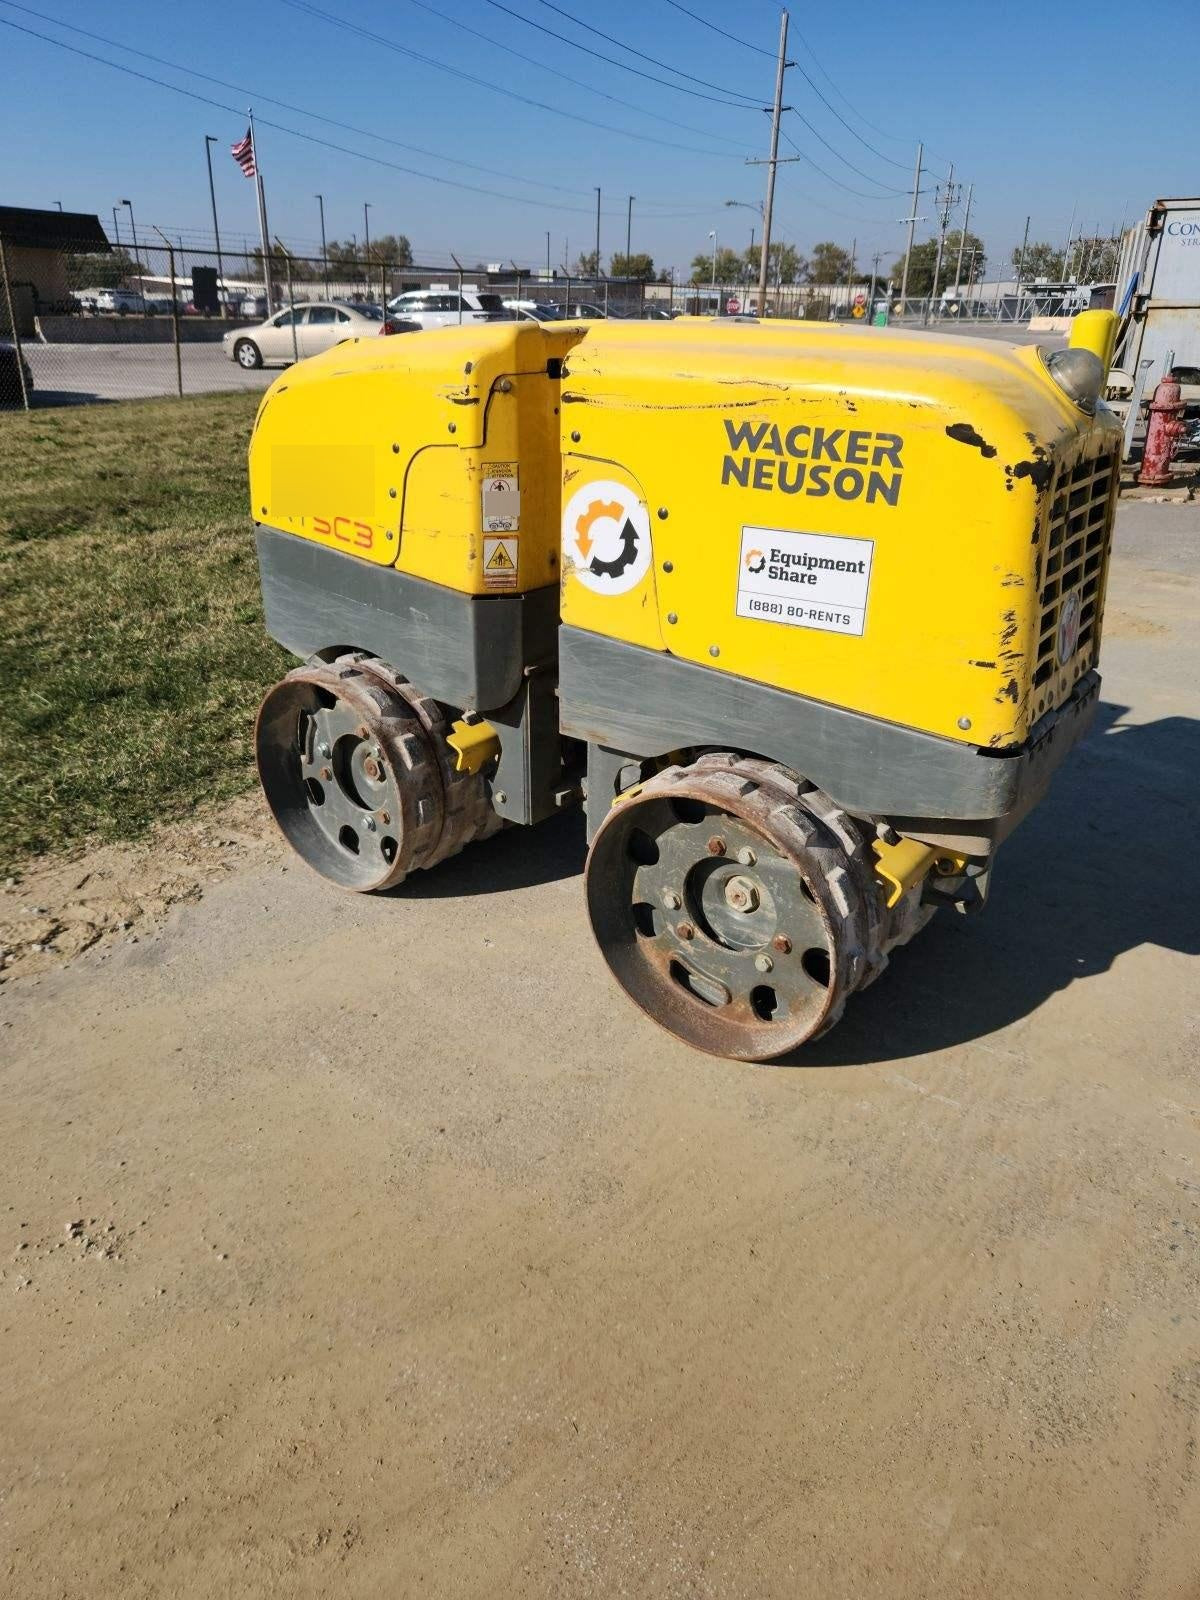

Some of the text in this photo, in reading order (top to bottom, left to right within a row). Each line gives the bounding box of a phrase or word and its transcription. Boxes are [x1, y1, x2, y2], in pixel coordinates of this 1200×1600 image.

[1180, 238, 1200, 246] STR
[723, 419, 904, 468] WACKER
[721, 455, 902, 506] NEUSON
[769, 549, 865, 574] Equipment
[768, 566, 817, 585] Share
[749, 599, 851, 625] (888) 80-RENTS
